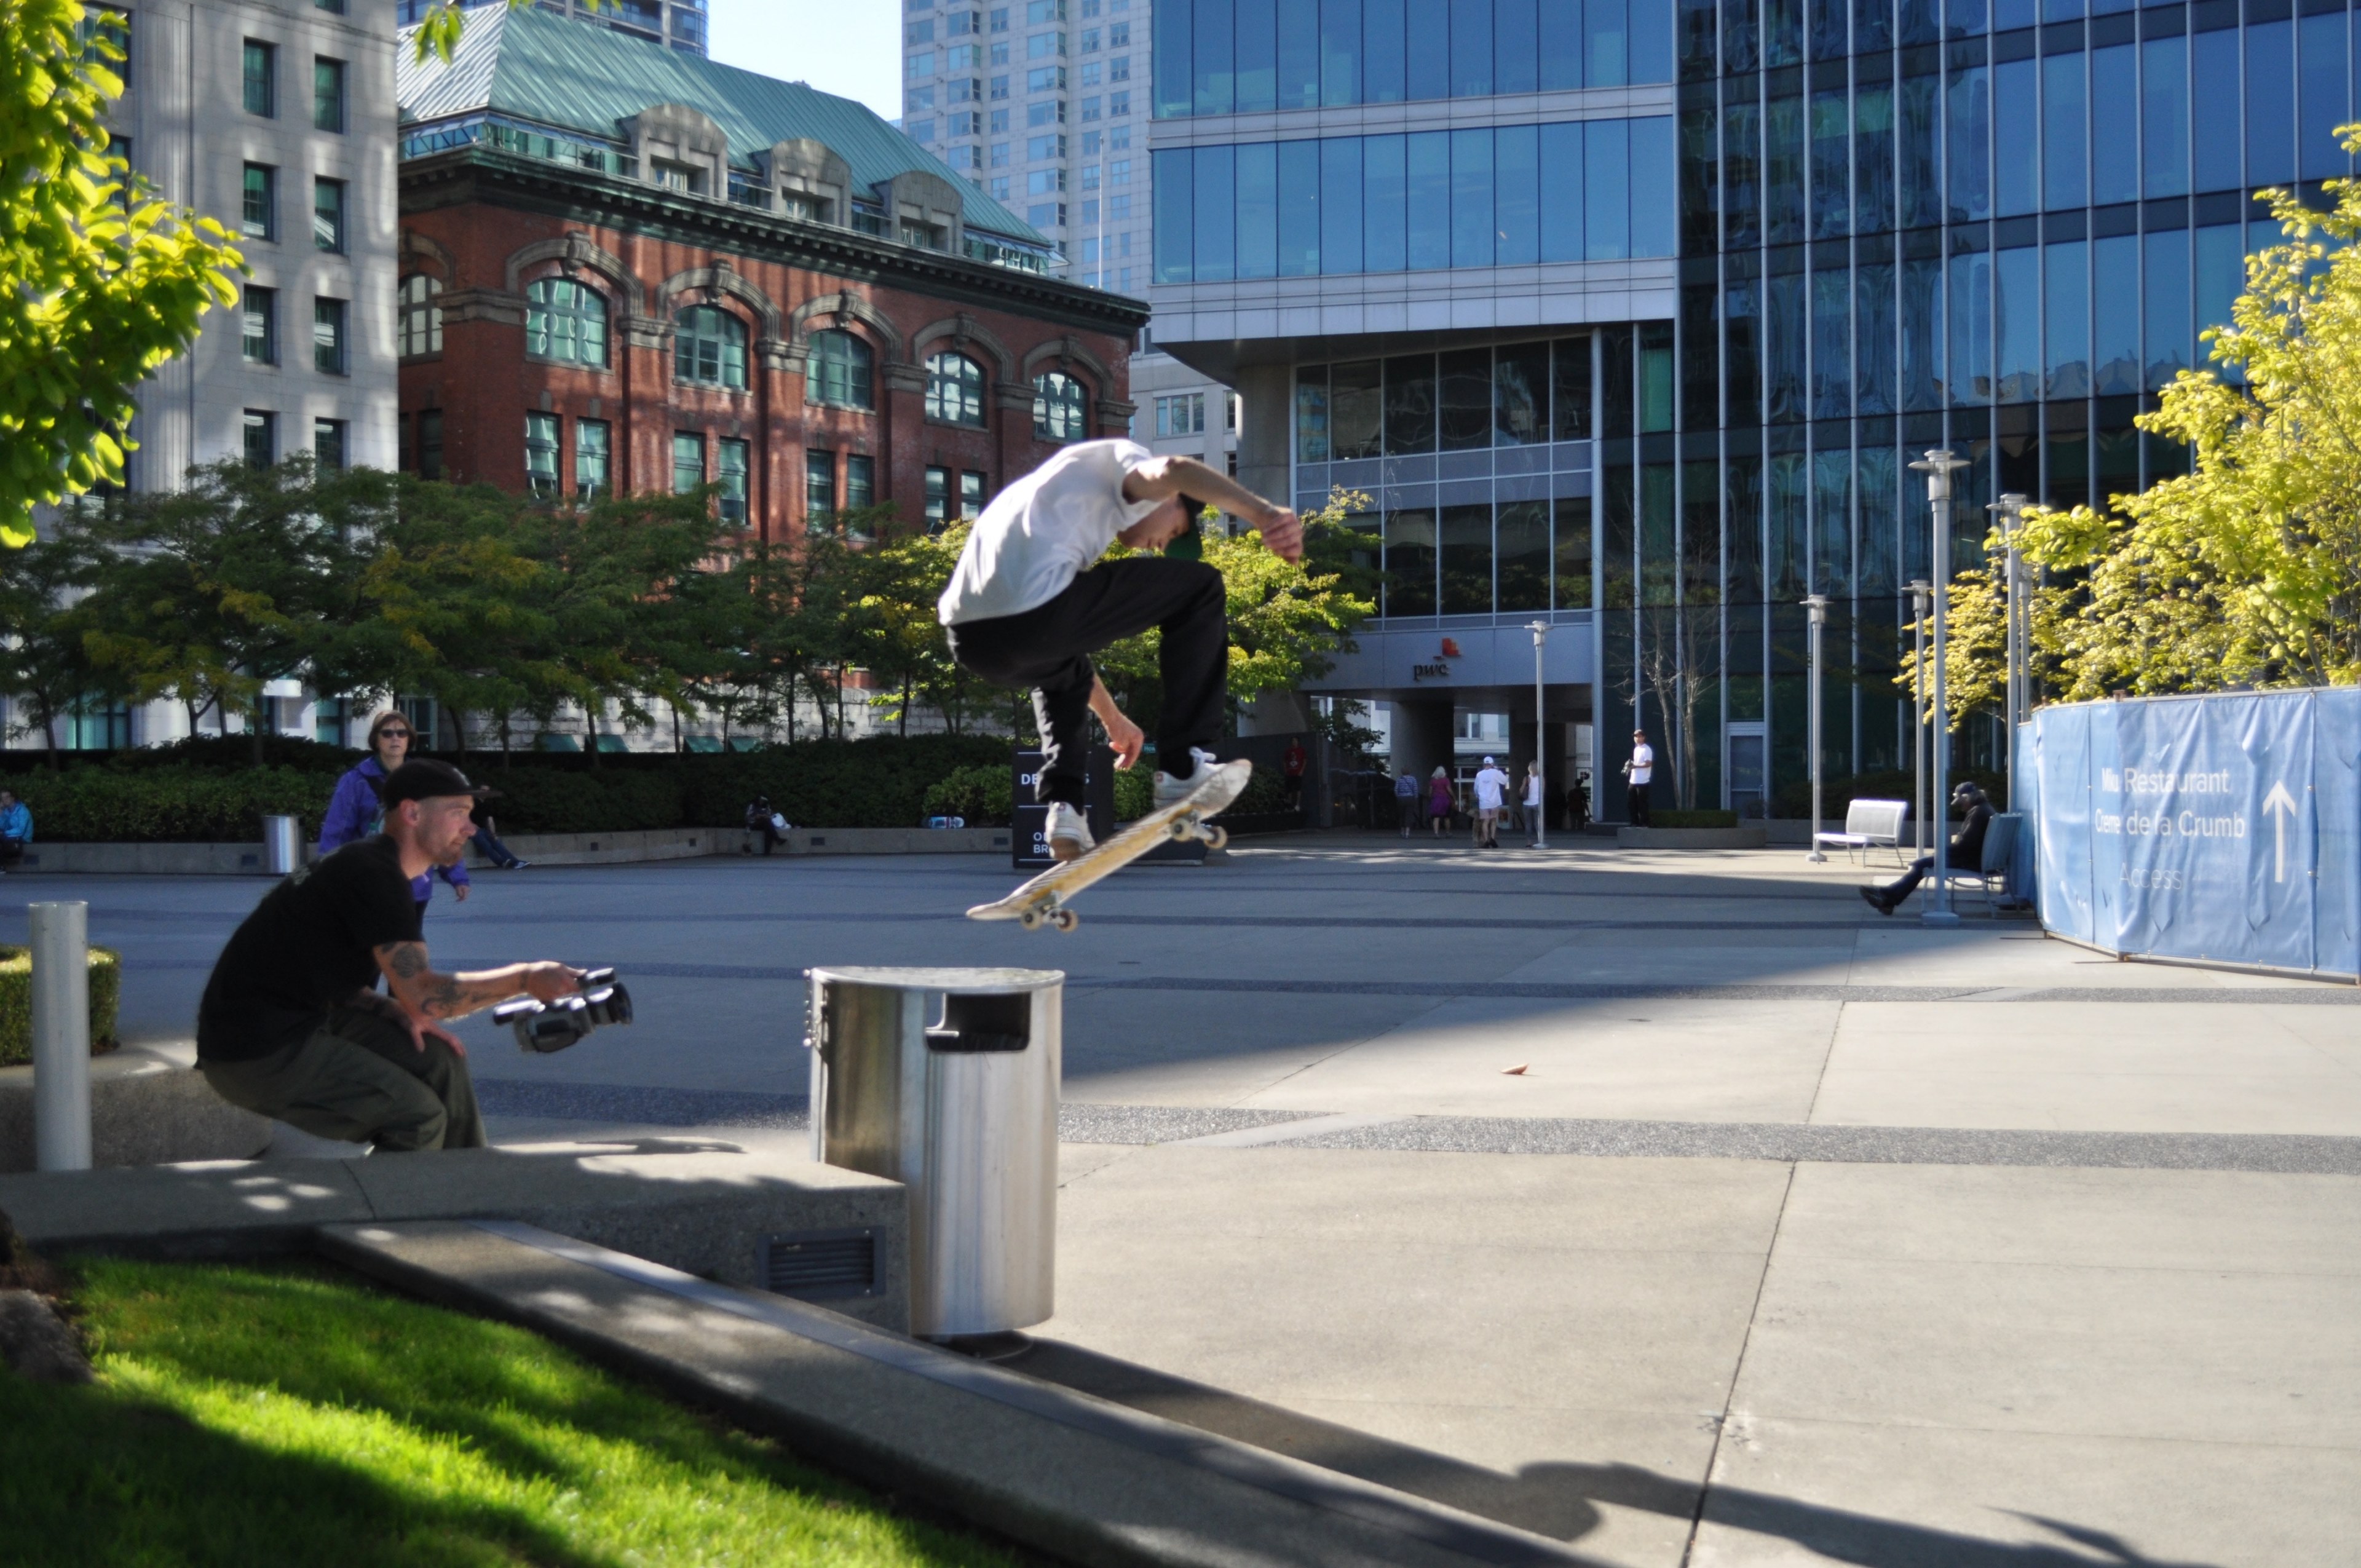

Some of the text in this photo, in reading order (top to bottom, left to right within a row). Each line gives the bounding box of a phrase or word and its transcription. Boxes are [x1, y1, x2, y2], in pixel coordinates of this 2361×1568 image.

[1413, 664, 1449, 681] pwc
[2124, 767, 2229, 793] Restaurant
[2126, 810, 2150, 835] de
[2154, 810, 2172, 836] la
[2178, 810, 2245, 837] Crumb
[2119, 862, 2181, 890] Access
